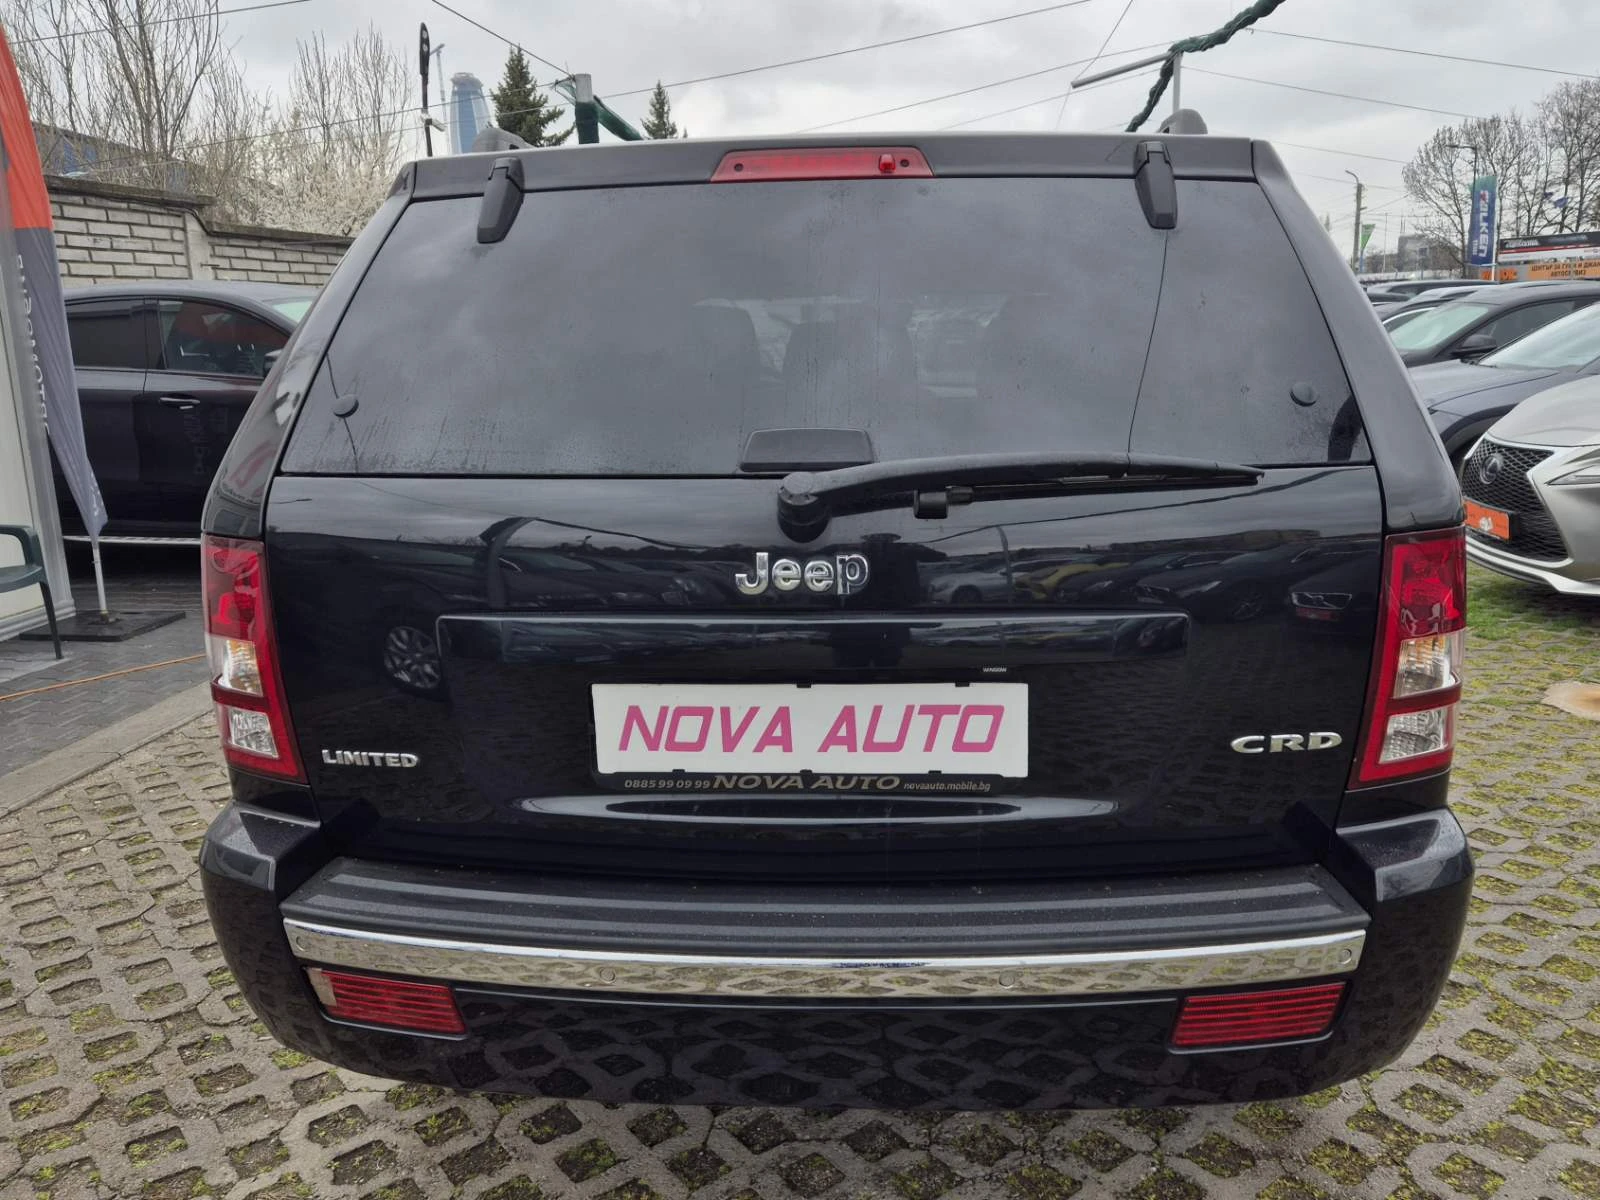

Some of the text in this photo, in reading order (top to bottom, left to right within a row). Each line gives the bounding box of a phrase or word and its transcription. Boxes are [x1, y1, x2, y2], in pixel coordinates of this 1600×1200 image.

[735, 551, 869, 596] Jeep
[618, 704, 1006, 754] NOVA AUTO
[1230, 731, 1343, 754] CRD
[322, 749, 420, 768] LIMITED
[624, 775, 991, 792] 0885 99 09 99 NOVA AUTO novaauto.mobile.bg
